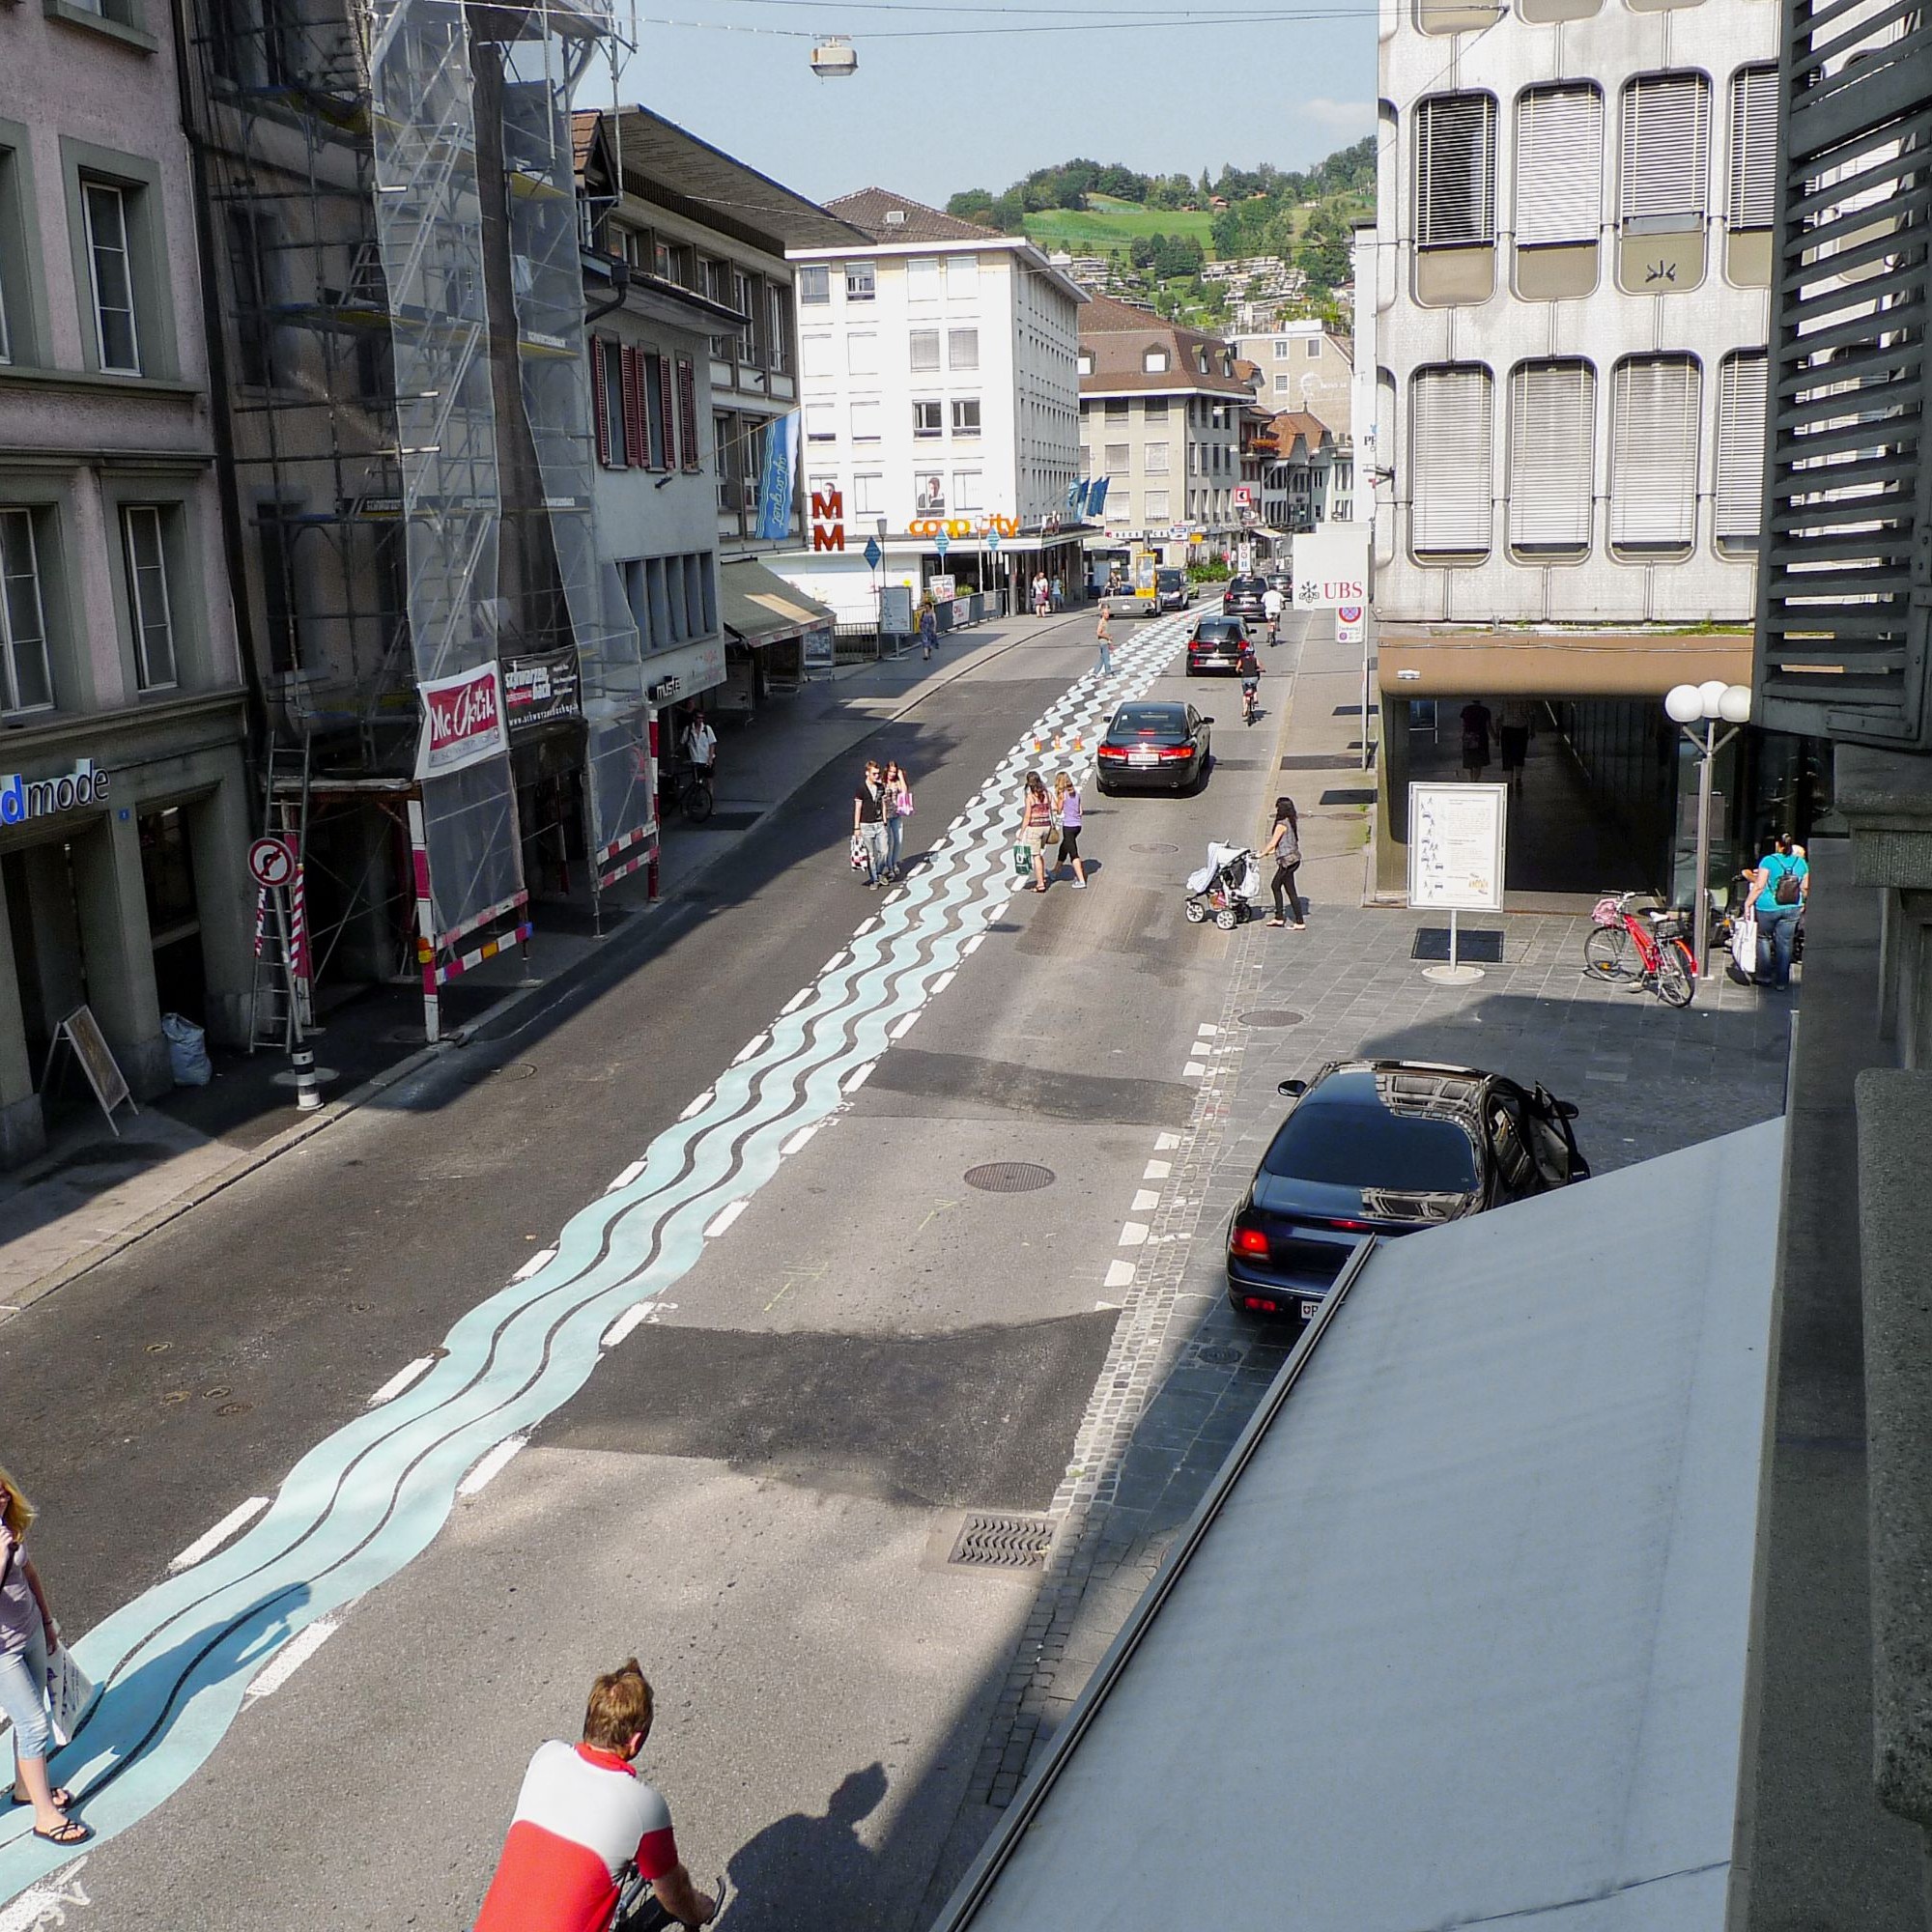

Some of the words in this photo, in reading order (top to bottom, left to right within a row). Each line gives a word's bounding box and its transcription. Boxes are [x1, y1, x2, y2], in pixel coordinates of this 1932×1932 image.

[909, 518, 971, 539] coop
[1324, 581, 1363, 600] UBS
[0, 758, 110, 827] dmode
